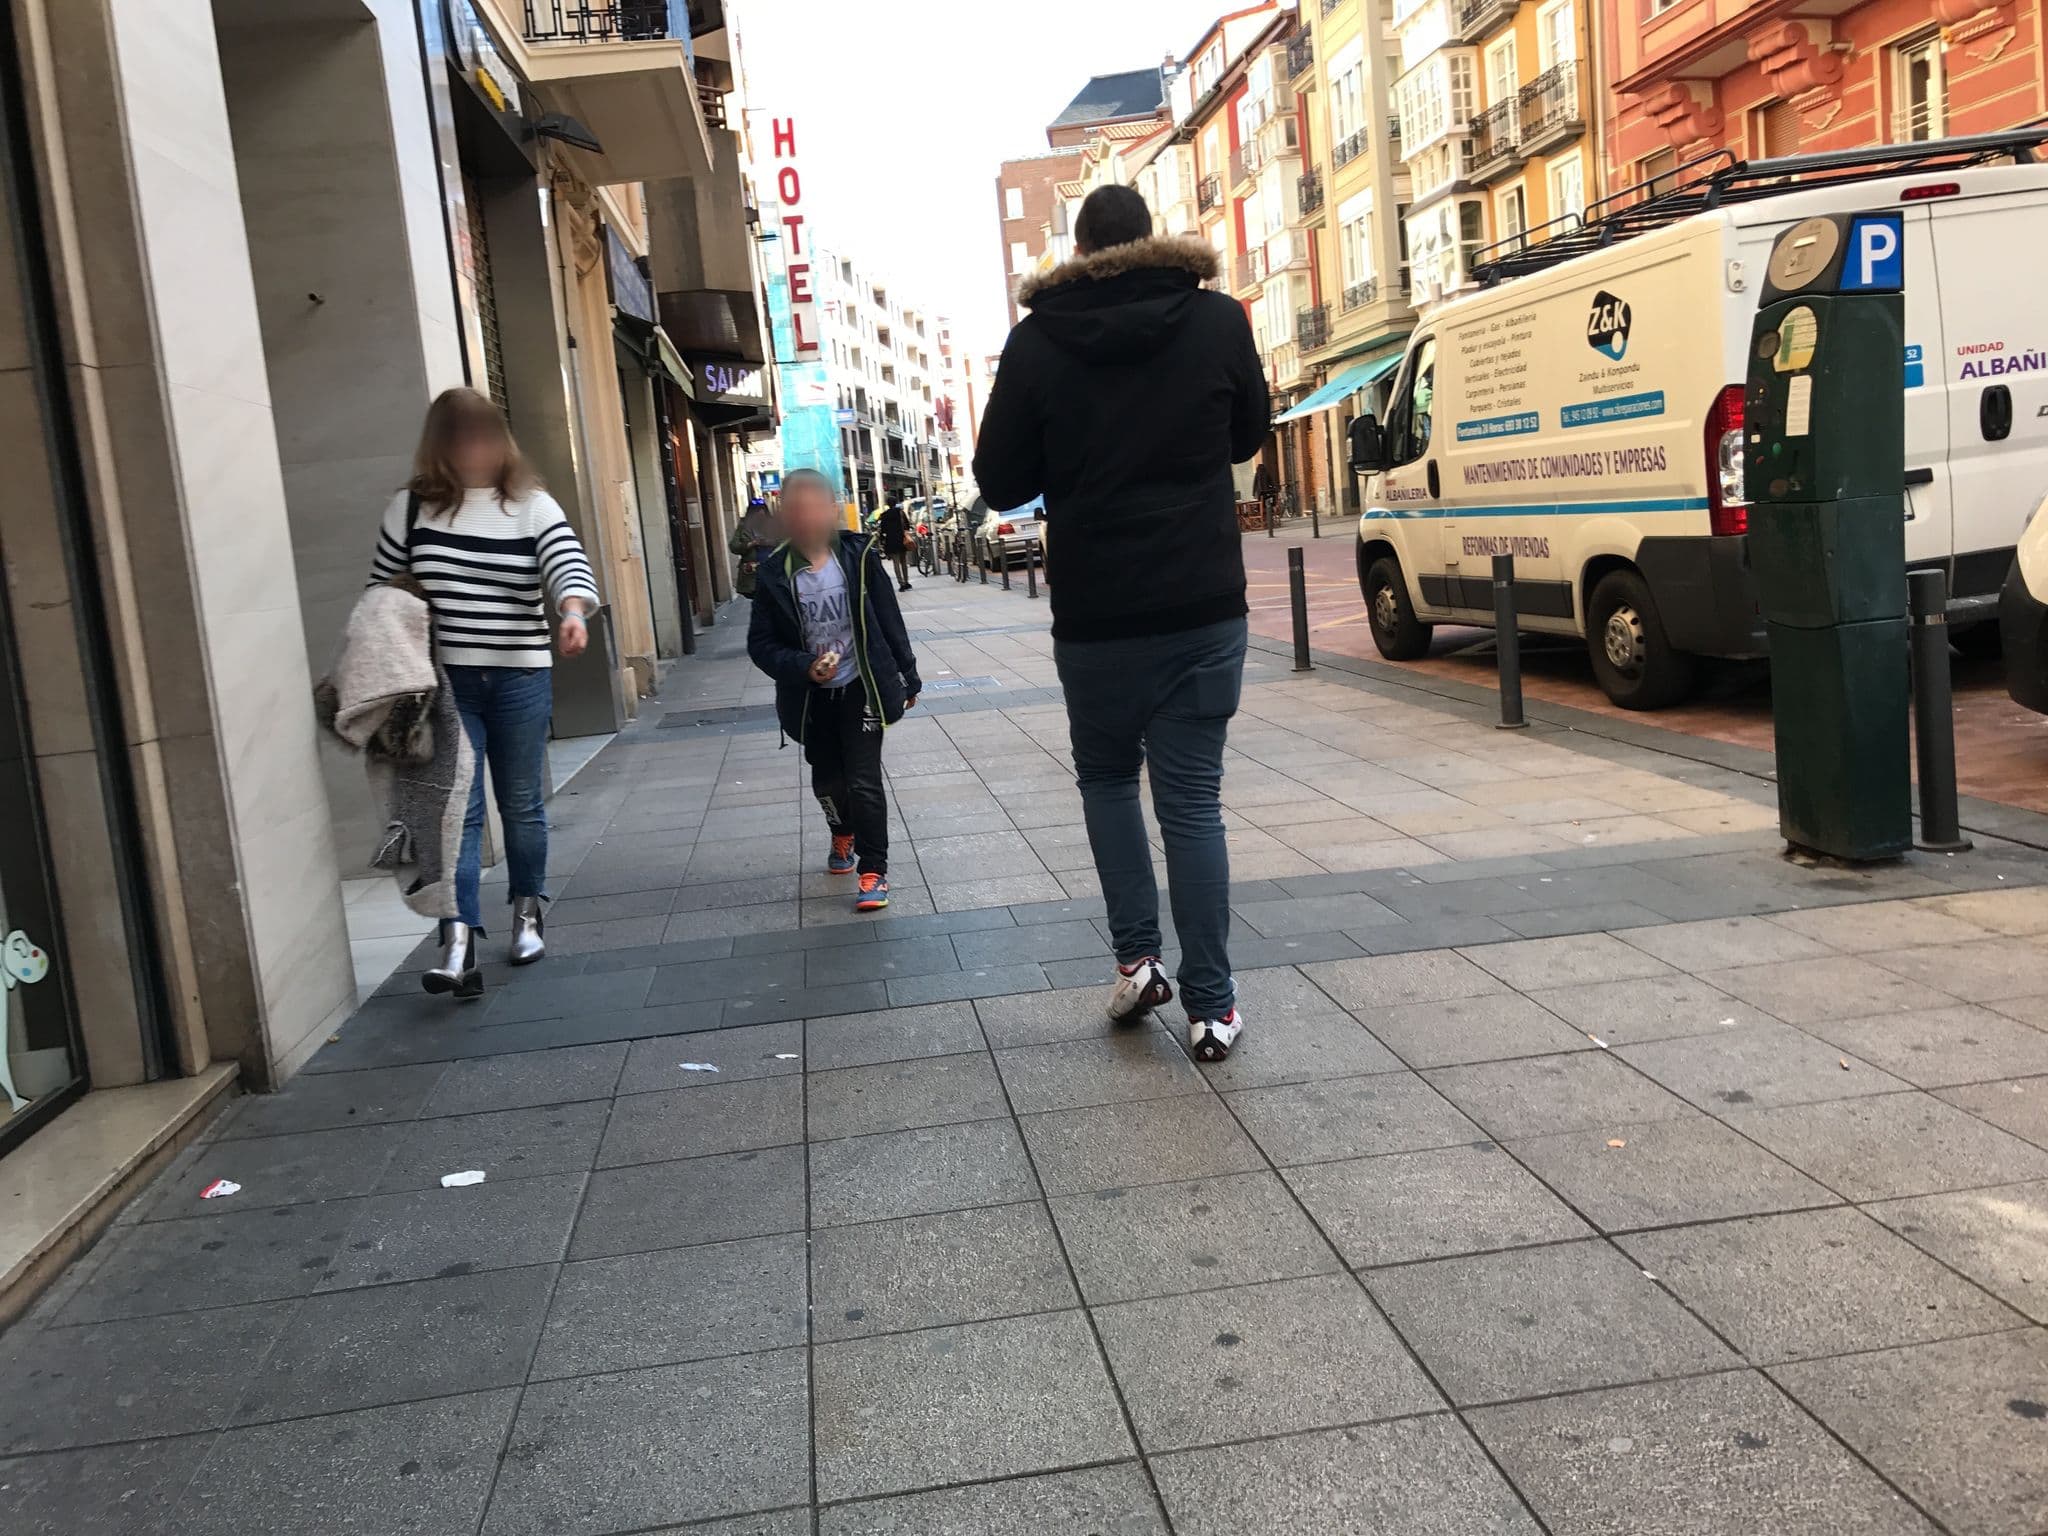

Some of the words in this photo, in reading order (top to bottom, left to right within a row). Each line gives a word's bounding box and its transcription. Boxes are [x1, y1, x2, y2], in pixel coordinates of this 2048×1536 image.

[772, 117, 818, 351] HOTEL
[1861, 223, 1897, 285] P
[1588, 300, 1627, 336] Z&K
[1906, 348, 1918, 359] 52
[1957, 341, 2004, 356] UNIDAD
[1960, 348, 2047, 380] ALBAÑI
[1463, 458, 1526, 485] MANTENIMIENTOS
[1528, 457, 1540, 480] DE
[1540, 452, 1604, 479] COMUNIDADES
[1605, 452, 1612, 475] Y
[1613, 445, 1667, 474] EMPRESAS
[1462, 536, 1498, 556] REFORMAS
[1499, 536, 1509, 555] DE
[1510, 536, 1550, 559] VIVIENDAS
